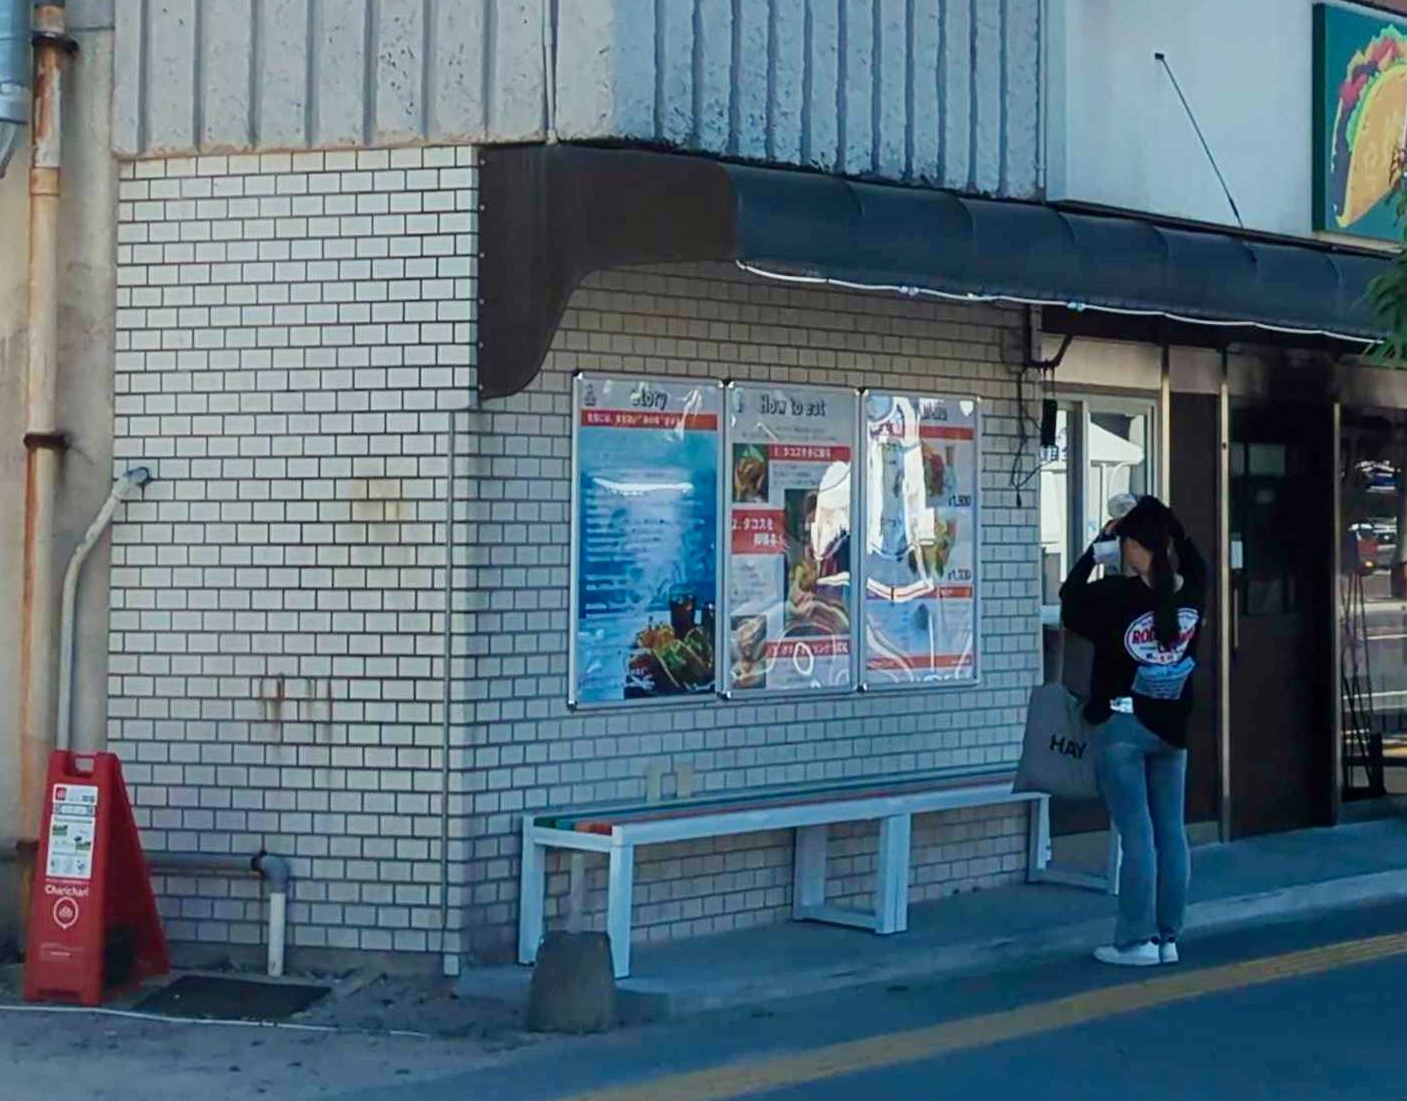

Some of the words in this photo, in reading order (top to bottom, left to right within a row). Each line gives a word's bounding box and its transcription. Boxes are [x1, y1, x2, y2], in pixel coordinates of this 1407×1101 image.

[761, 394, 788, 415] How
[790, 398, 804, 416] to
[806, 399, 826, 417] eat
[1050, 734, 1087, 760] HAY
